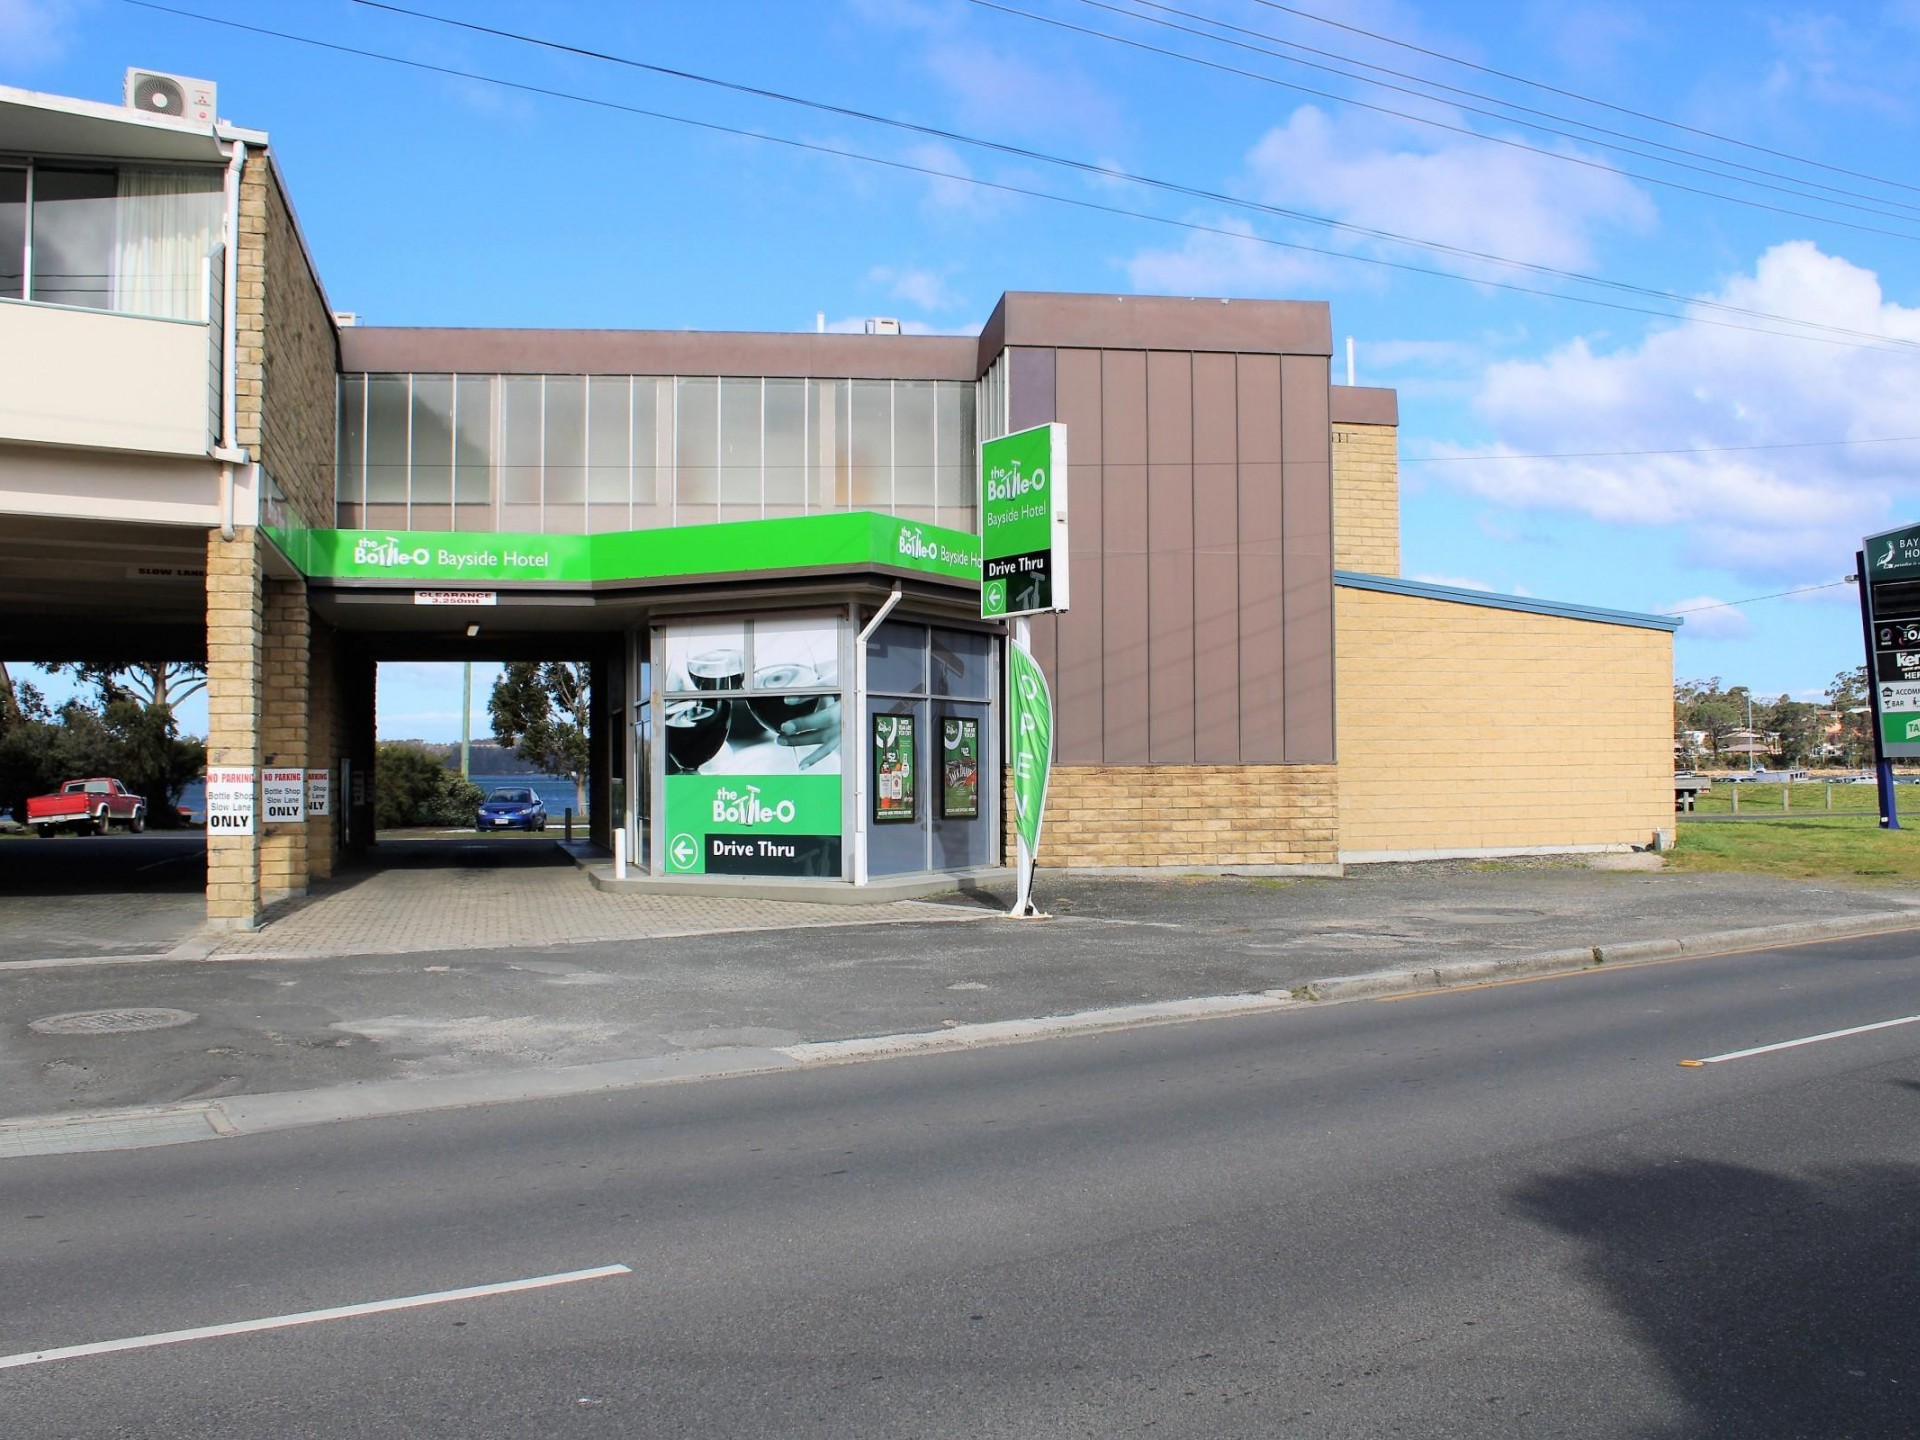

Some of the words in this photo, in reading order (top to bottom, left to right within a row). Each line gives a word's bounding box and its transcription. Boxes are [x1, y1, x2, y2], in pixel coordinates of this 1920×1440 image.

[991, 466, 1004, 478] the
[987, 510, 1019, 528] Bayside
[1021, 500, 1047, 519] Hotel
[902, 526, 911, 538] the
[358, 538, 378, 549] the
[1900, 537, 1920, 548] BAY
[438, 549, 498, 570] Bayside
[503, 551, 549, 567] Hotel
[940, 545, 968, 567] Bayside
[138, 568, 172, 576] SLOW
[989, 561, 1016, 577] Drive
[1019, 557, 1044, 572] Thru
[207, 773, 218, 783] NO
[264, 773, 272, 781] NO
[274, 772, 301, 781] PARKING
[264, 787, 282, 796] Bottle
[284, 787, 301, 797] Shop
[313, 785, 327, 794] Shop
[717, 787, 737, 800] the
[208, 791, 231, 800] Bottle
[233, 791, 254, 802] Shop
[266, 796, 282, 805] Slow
[283, 796, 300, 804] Lane
[210, 802, 229, 812] Slow
[232, 802, 252, 812] Lane
[268, 806, 299, 817] ONLY
[210, 815, 249, 828] ONLY
[713, 840, 754, 857] Drive
[757, 841, 795, 858] Thru
